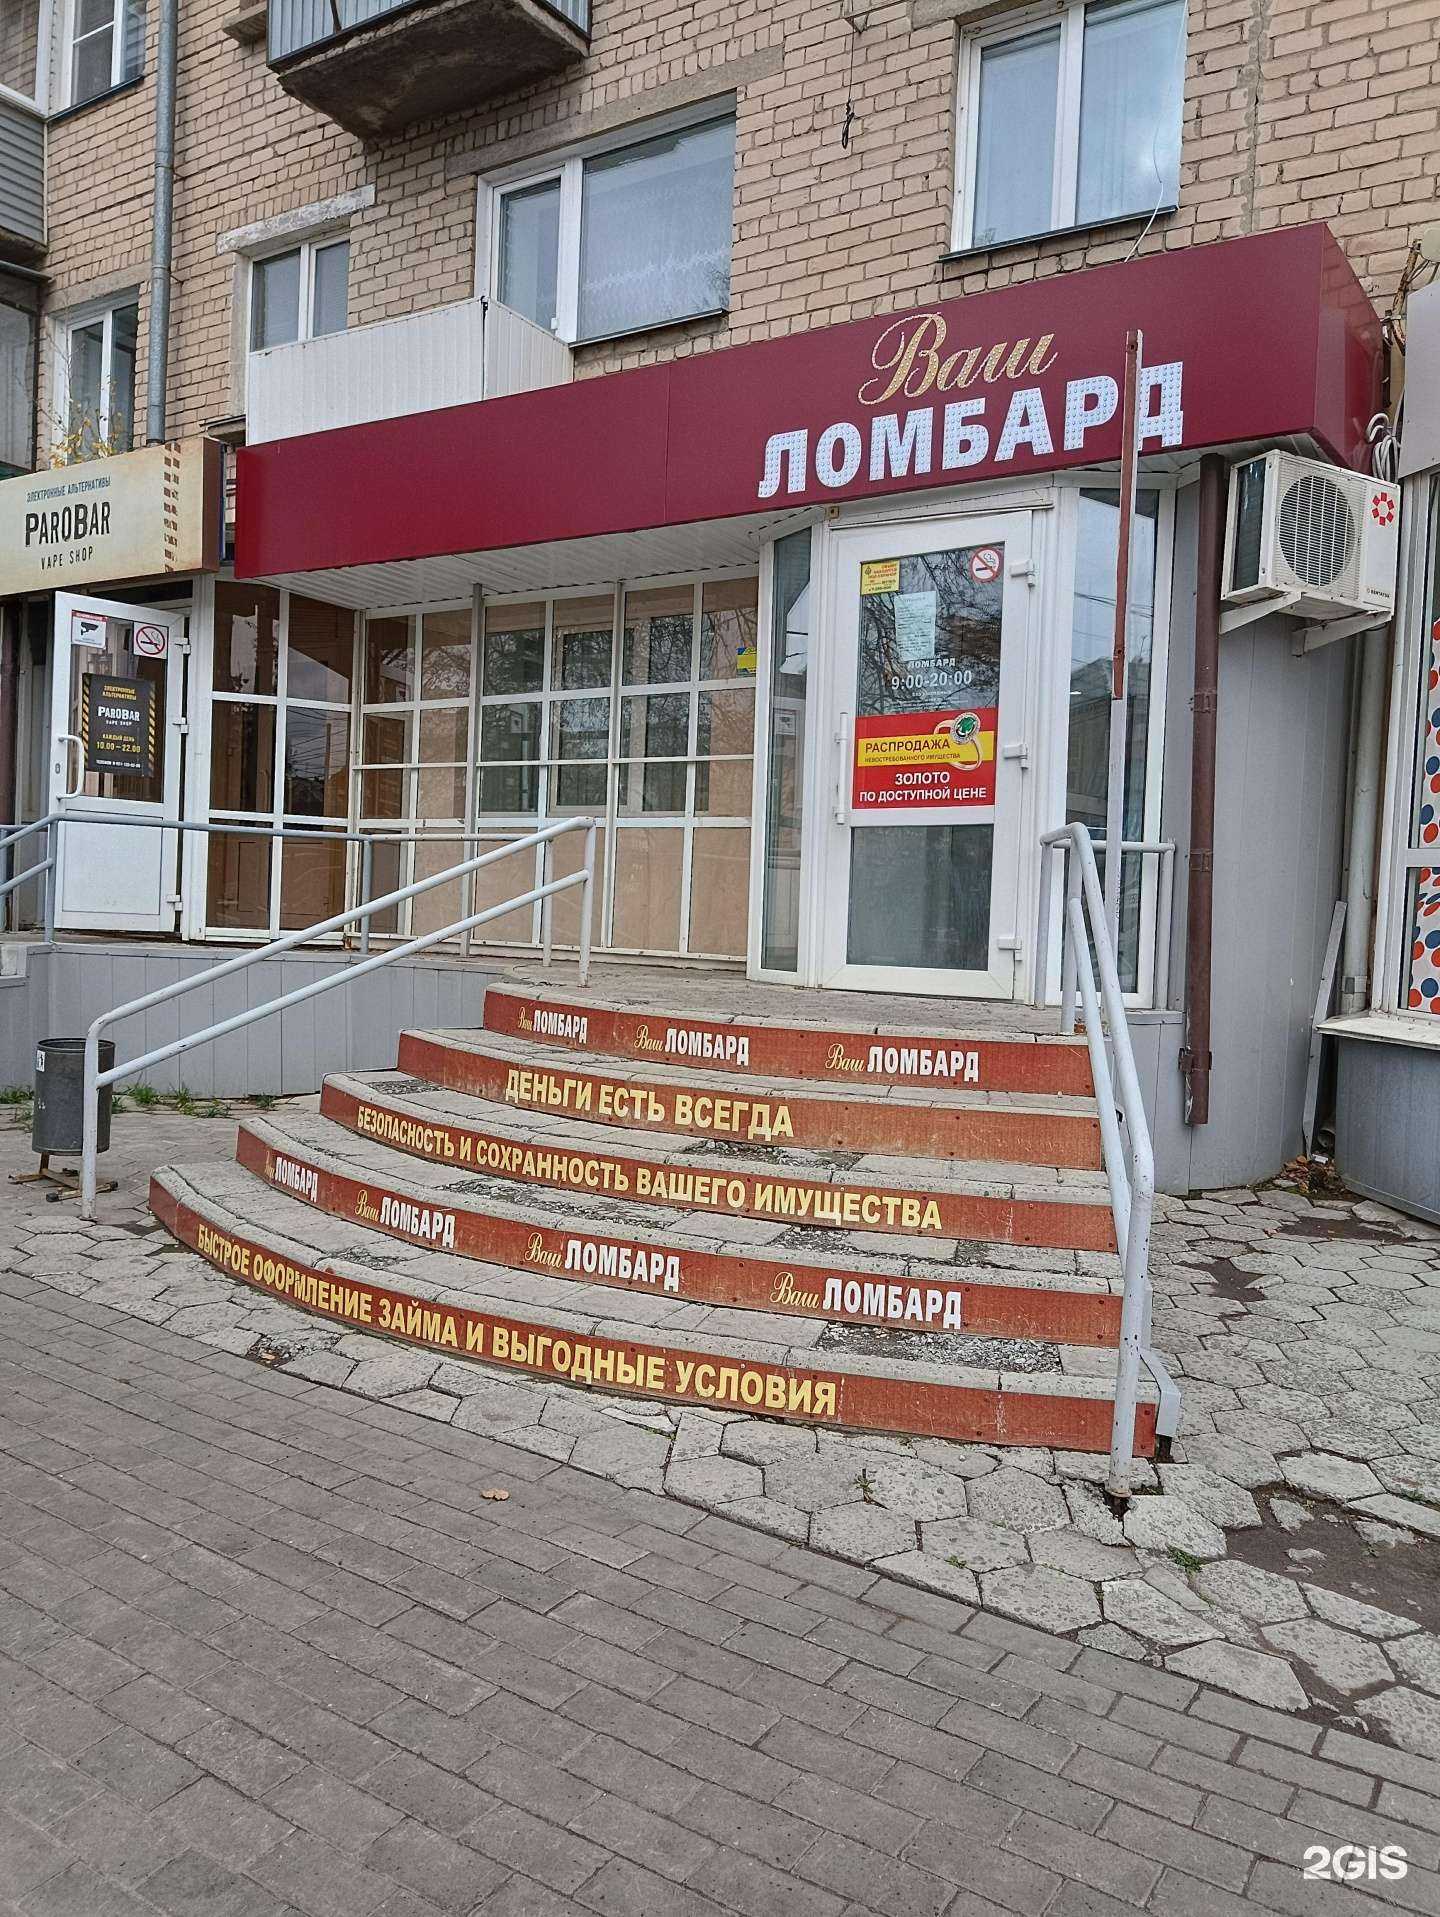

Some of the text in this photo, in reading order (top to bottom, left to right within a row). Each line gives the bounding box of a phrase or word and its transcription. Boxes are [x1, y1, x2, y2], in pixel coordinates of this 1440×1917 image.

[858, 313, 1058, 405] Ваш
[757, 361, 1184, 499] ЛОМБАРД
[67, 475, 111, 495] АЛЬТЕРНАТИВЫ
[24, 501, 111, 548] PAROBAR
[40, 545, 94, 571] VAPE SHOP
[891, 669, 973, 691] 9:00-20:00
[907, 657, 956, 669] ЛОМБАРД
[97, 705, 141, 722] PAROBAR
[865, 738, 950, 754] РАСПРОДАЖА
[925, 752, 961, 761] ИМУЩЕСТВА
[859, 786, 987, 804] ПО ДОСТУПНОЙ ЦЕНЕ
[894, 771, 950, 786] ЗОЛОТО
[533, 1009, 588, 1044] ЛОМБАРД
[633, 1023, 750, 1066] Ваш ЛОМБАРД
[825, 1043, 980, 1083] Ваш ЛОМБАРД
[505, 1068, 795, 1142] ДЕНЬГИ ЕСТЬ ВСЕГДА
[275, 1156, 319, 1202] ЛОМБАРД
[357, 1105, 943, 1231] БЕЗОПАСНОСТЬ И СОХРАННОСТЬ ВАШЕГО ИМУЩЕСТВА
[355, 1189, 456, 1249] Ваш ЛОМБАРД
[524, 1232, 681, 1293] Ваш ЛОМБАРД
[197, 1224, 837, 1416] БЫСТРОЕ ОФОРМЛЕНИЕ ЗАЙМА И ВЫГОДНЫЕ УСЛОВИЯ
[770, 1271, 963, 1330] Ваш ЛОМБАРД
